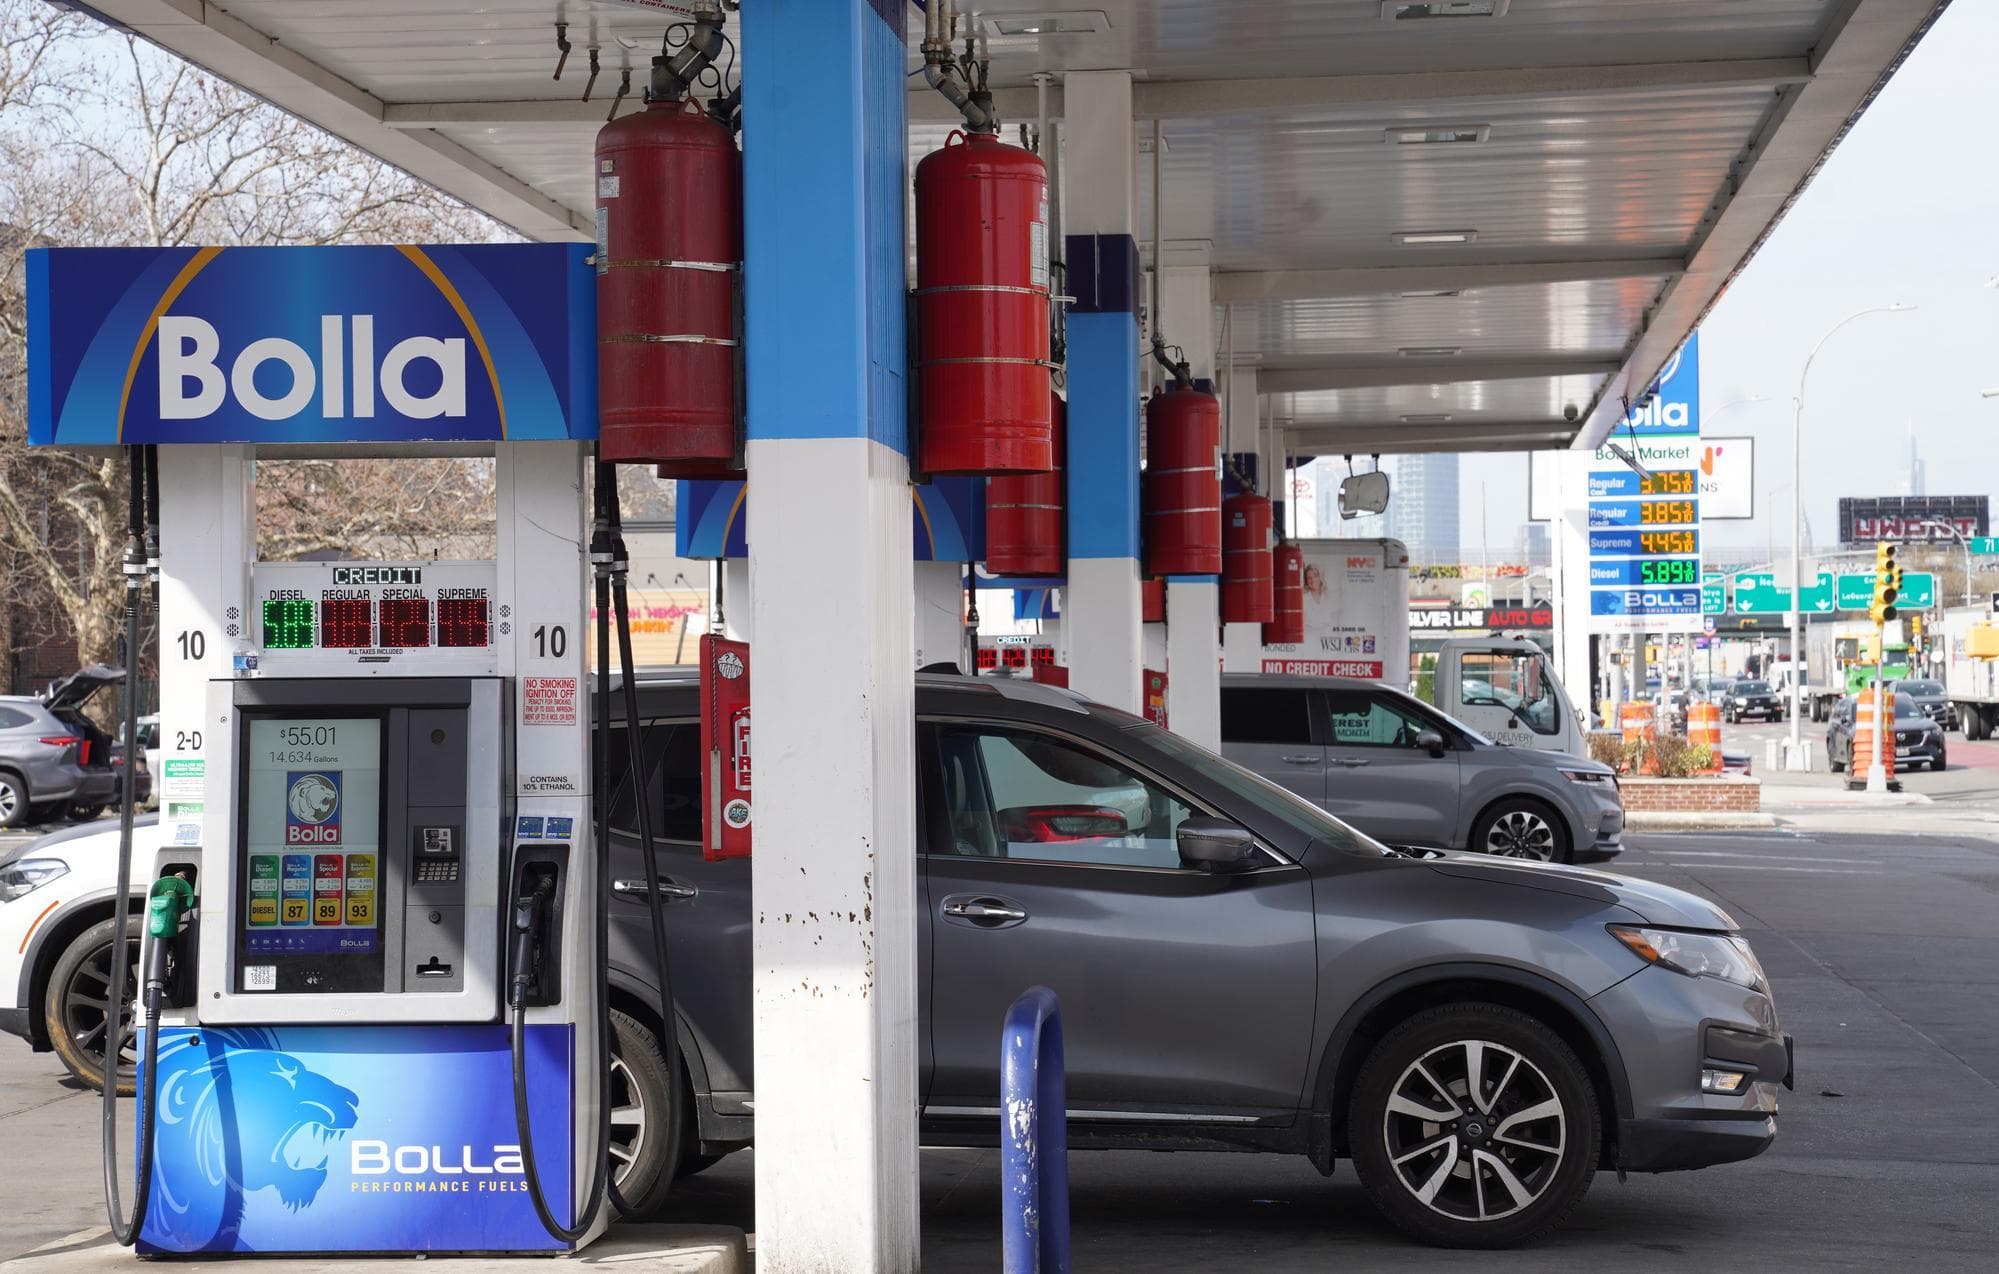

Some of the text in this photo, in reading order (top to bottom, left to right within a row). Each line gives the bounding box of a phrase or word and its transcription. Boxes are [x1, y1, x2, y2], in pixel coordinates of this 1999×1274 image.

[639, 0, 691, 14] CONTAINERS
[158, 314, 467, 421] Bolla
[1640, 446, 1690, 460] Market
[1589, 478, 1626, 490] Regular
[1589, 508, 1628, 519] Regular
[1641, 502, 1681, 524] 3.85
[1590, 538, 1632, 549] Supreme
[1641, 532, 1683, 554] 4.45
[335, 569, 420, 584] CREDIT
[1590, 568, 1620, 579] Diesel
[1641, 562, 1683, 584] 5.89
[269, 590, 306, 600] DIESEL
[322, 589, 371, 600] REGULAR
[382, 589, 426, 600] SPECIAL
[437, 589, 488, 600] SUPREME
[1454, 610, 1483, 626] LINE
[1488, 610, 1528, 626] AUTO
[177, 630, 206, 660] 10
[534, 625, 567, 658] 10
[997, 636, 1031, 644] CREDIT
[1265, 661, 1373, 677] NO CREDIT CHECK
[526, 680, 575, 689] NO SMOKING
[526, 690, 575, 698] IGNITION OFF
[177, 731, 202, 751] 2-D
[269, 751, 312, 763] 14.634
[739, 726, 751, 786] FIRE
[288, 826, 337, 842] Bolla
[288, 906, 304, 918] 87
[320, 905, 336, 918] 89
[352, 905, 368, 917] 93
[351, 1181, 528, 1193] PERFORMANCE FUELS
